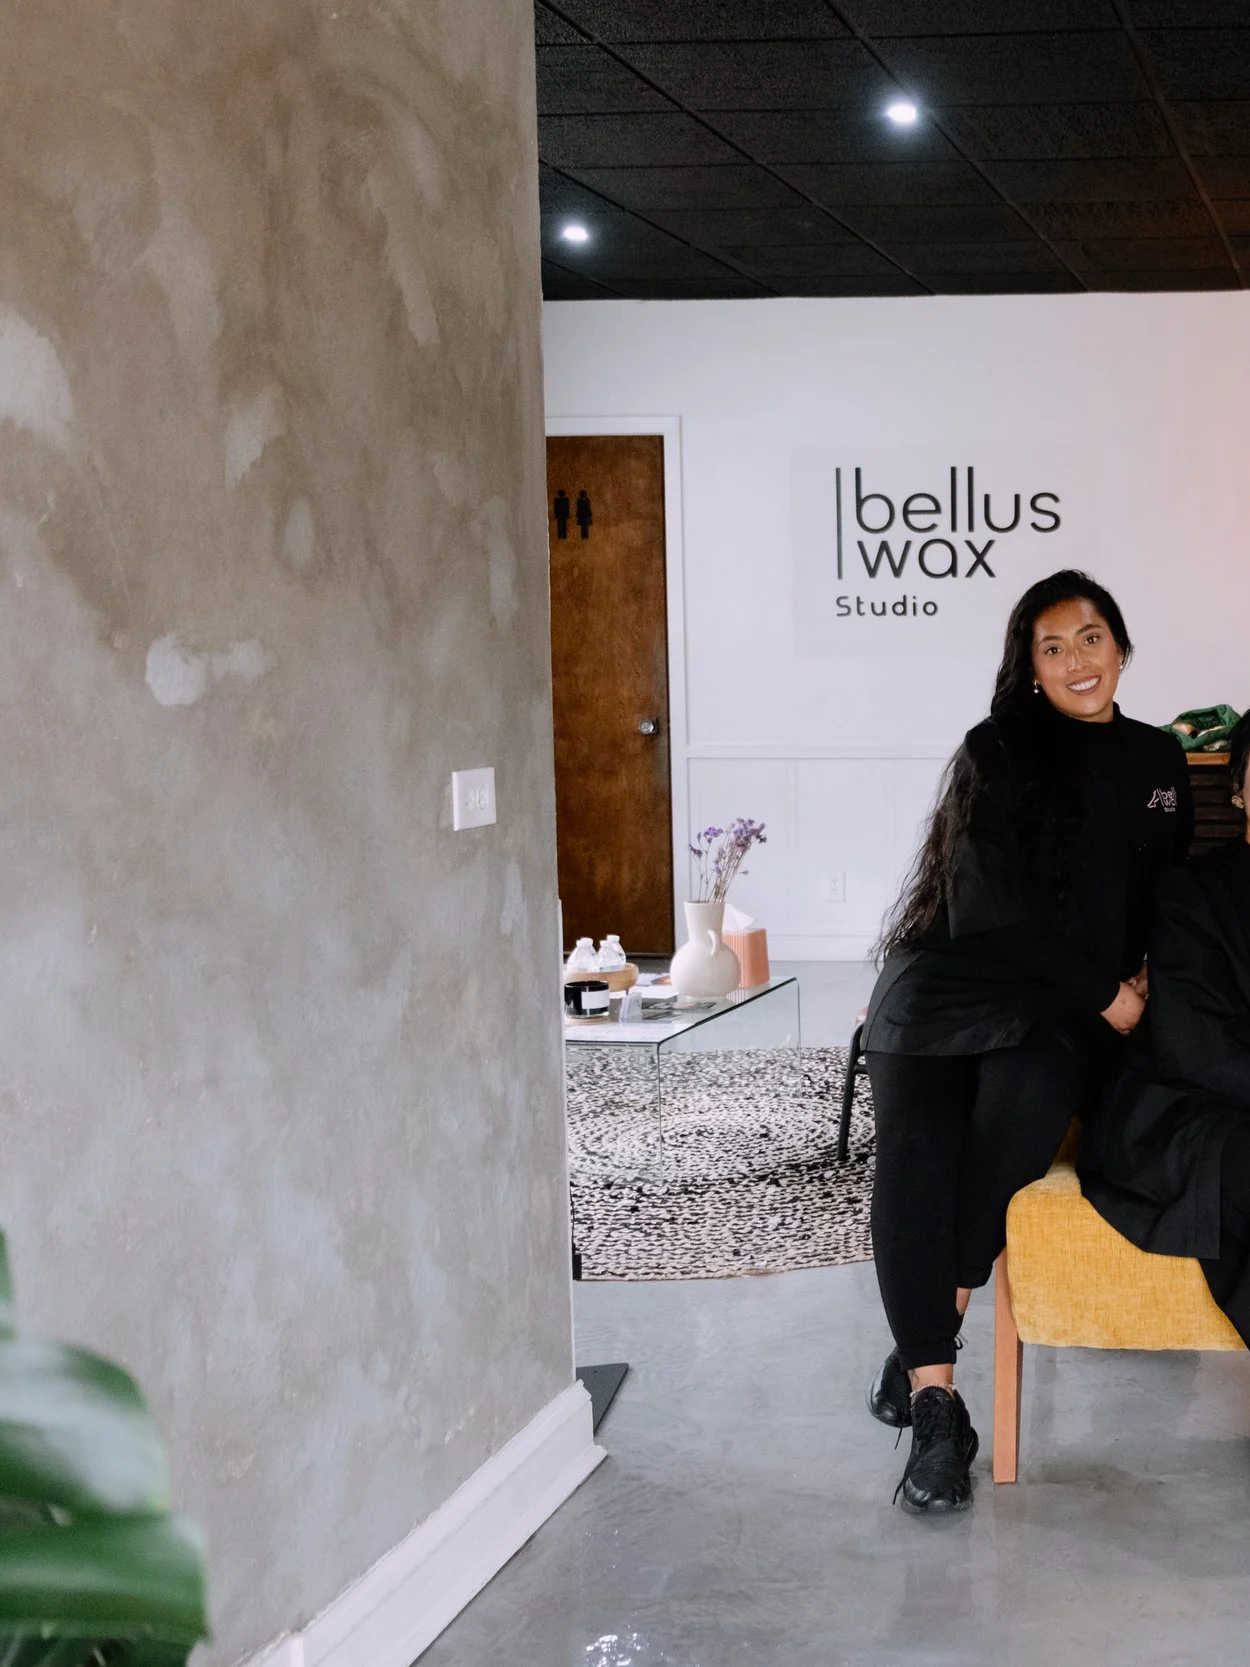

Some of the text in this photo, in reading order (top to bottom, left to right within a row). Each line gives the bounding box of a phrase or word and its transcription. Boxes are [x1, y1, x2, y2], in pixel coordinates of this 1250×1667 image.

[855, 466, 1061, 534] bellus
[857, 538, 996, 578] wax
[836, 595, 938, 616] Studio
